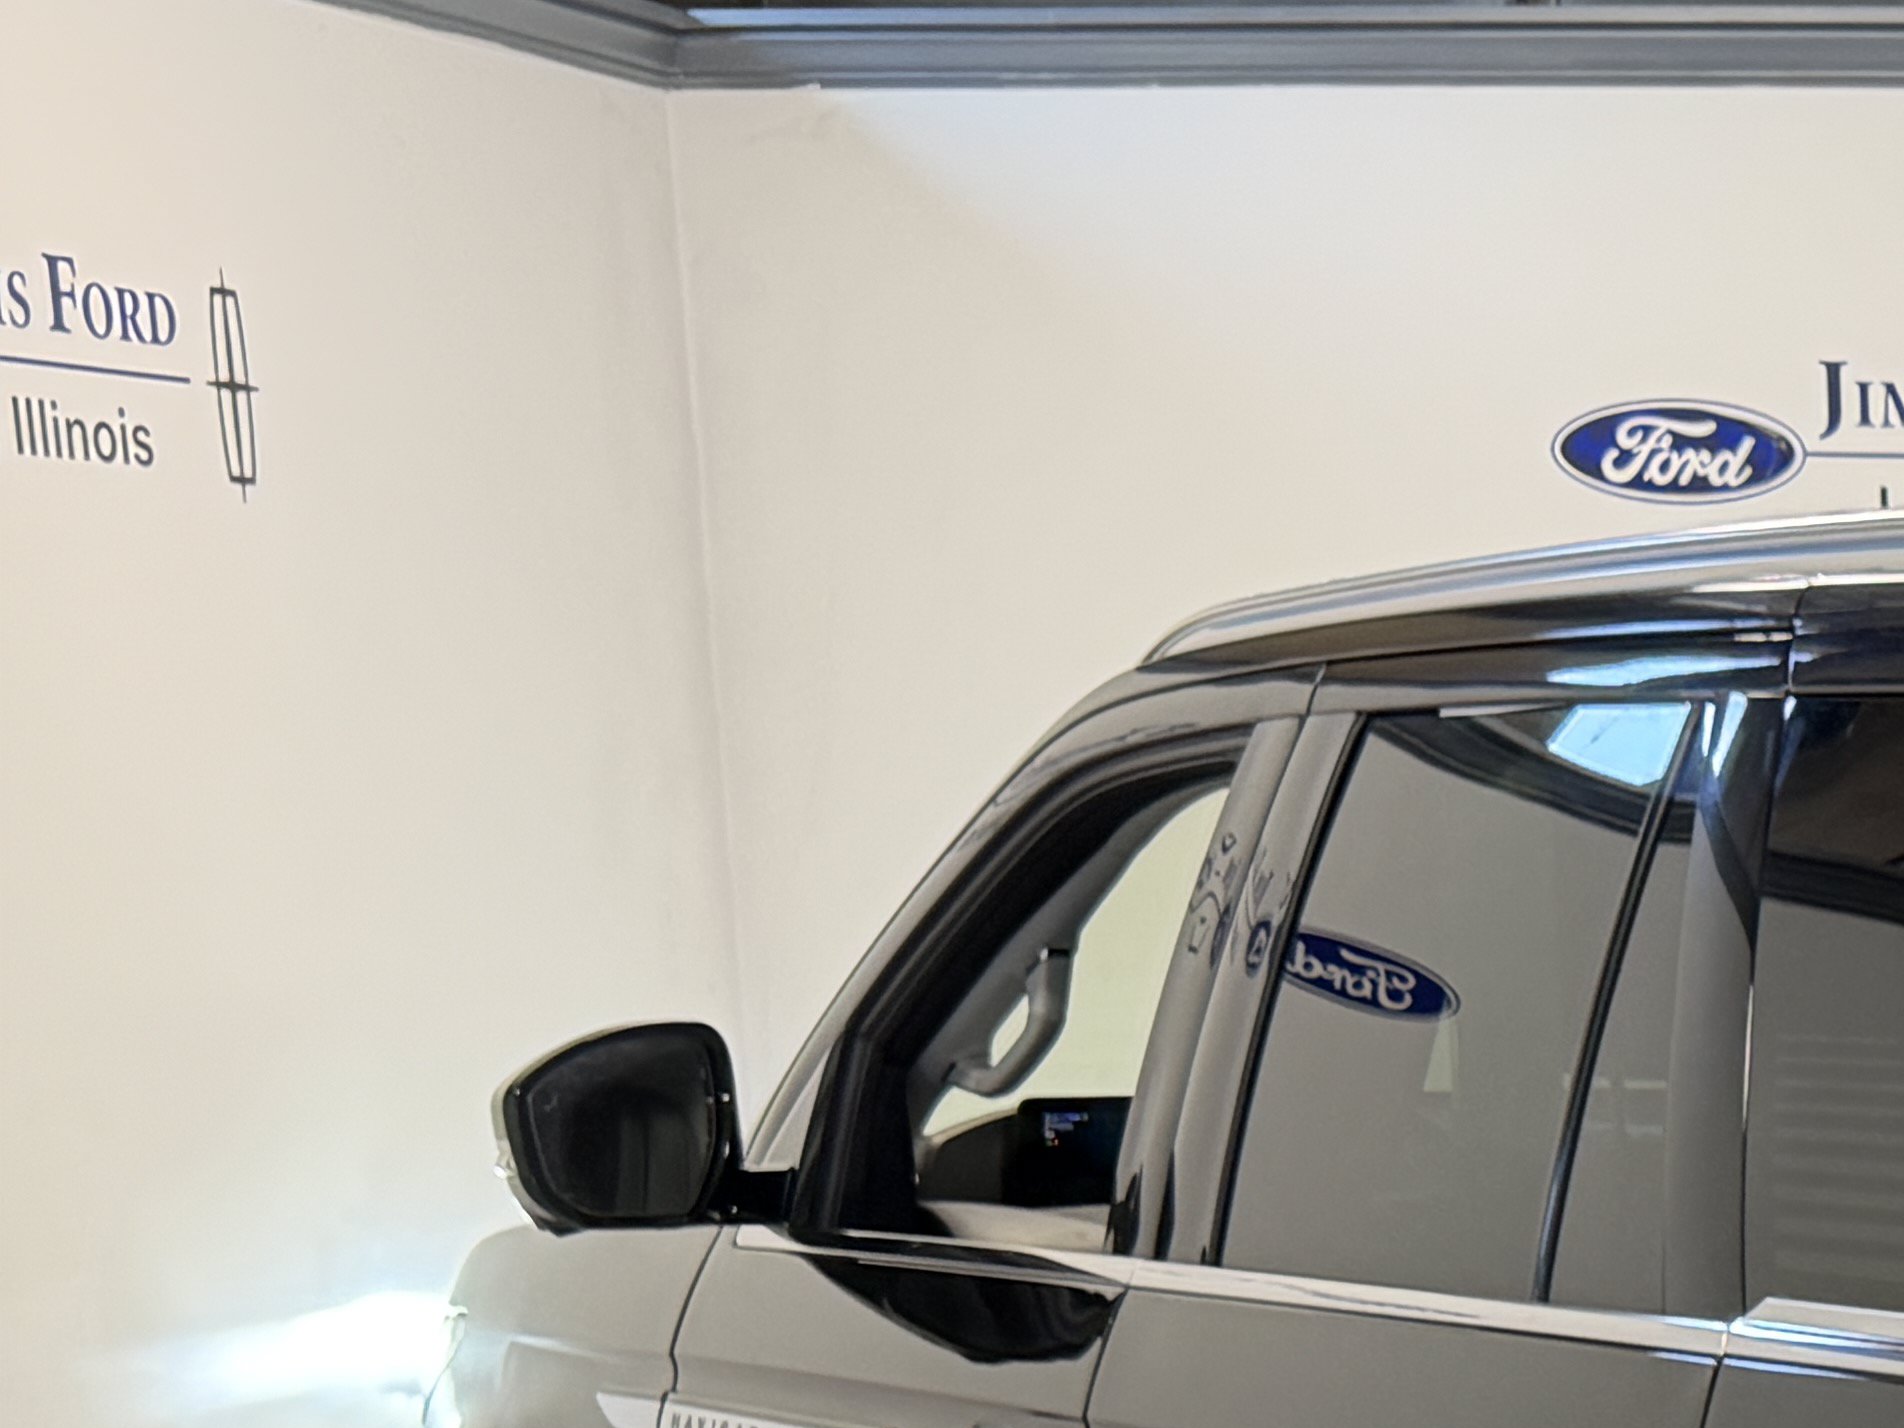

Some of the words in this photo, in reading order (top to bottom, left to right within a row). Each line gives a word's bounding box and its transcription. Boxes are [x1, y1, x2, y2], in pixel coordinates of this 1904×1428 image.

[41, 252, 177, 347] FORD
[11, 395, 154, 467] Illinois
[1600, 415, 1757, 488] Ford
